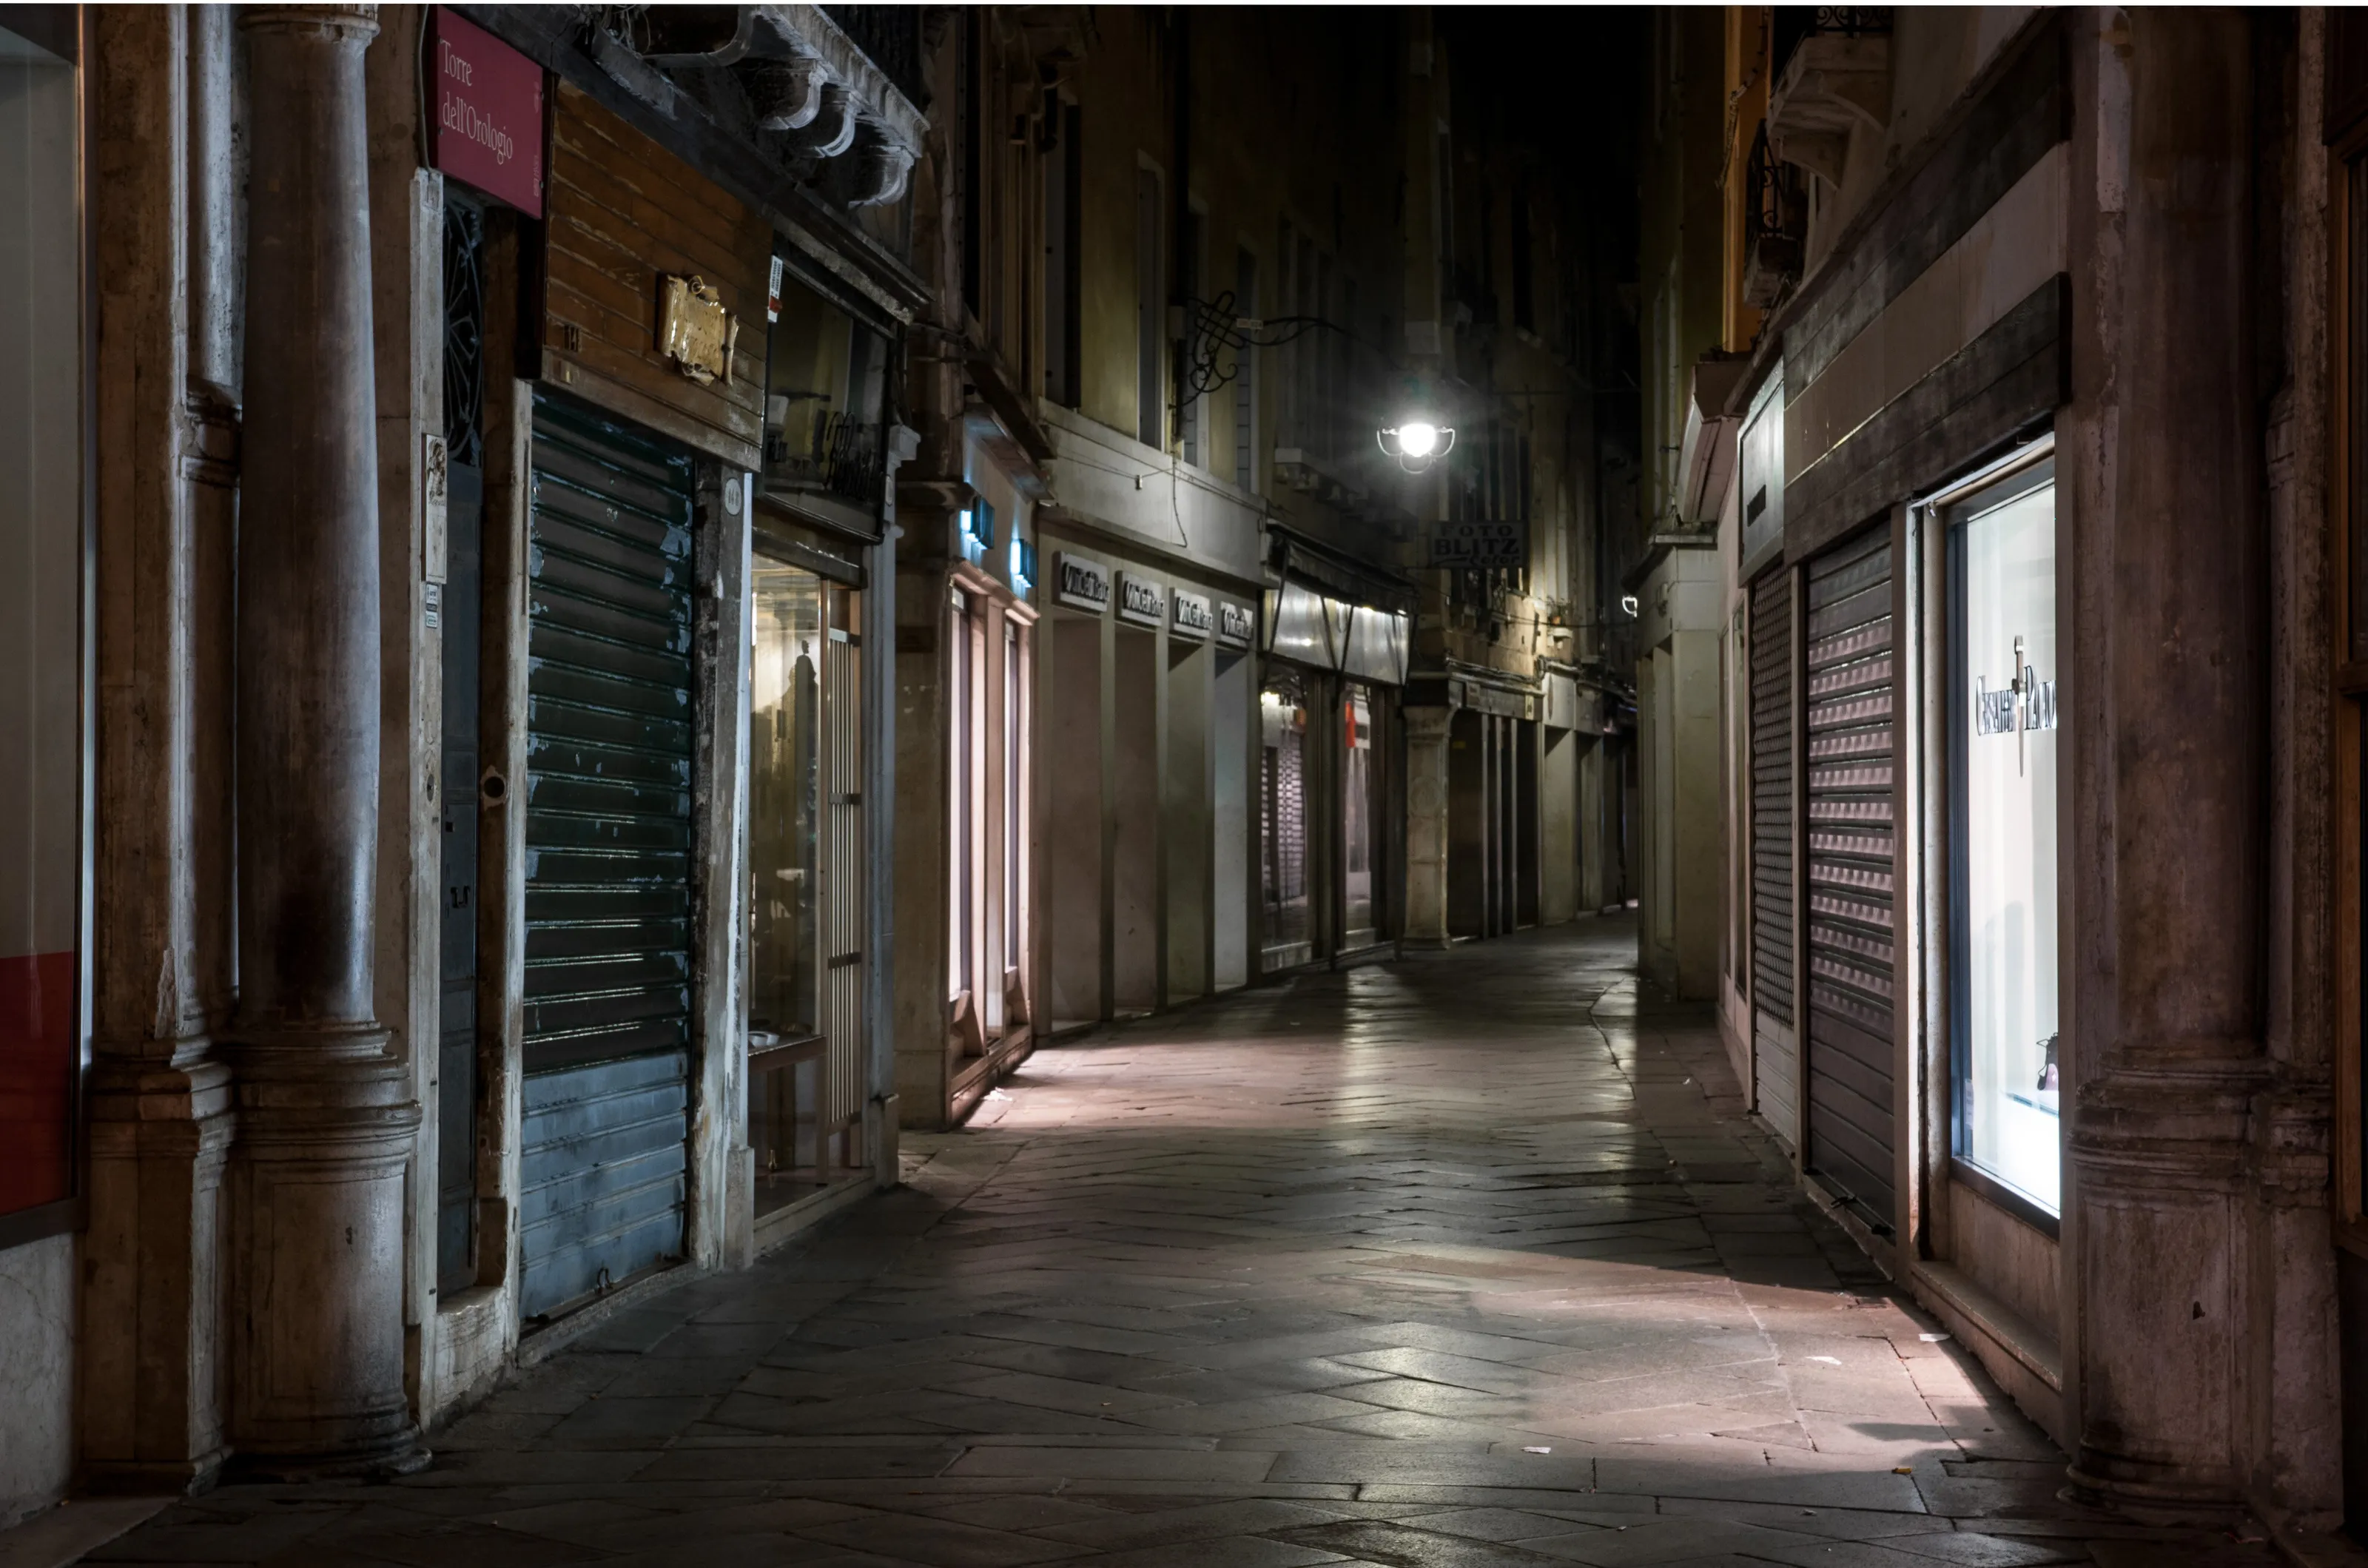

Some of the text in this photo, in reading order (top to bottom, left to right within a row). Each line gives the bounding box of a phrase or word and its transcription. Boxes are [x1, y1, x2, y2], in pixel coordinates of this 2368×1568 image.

[440, 39, 472, 86] Torre
[443, 91, 513, 165] dell'Orologio
[1434, 538, 1520, 555] BLITZ
[1439, 525, 1513, 537] FOTO
